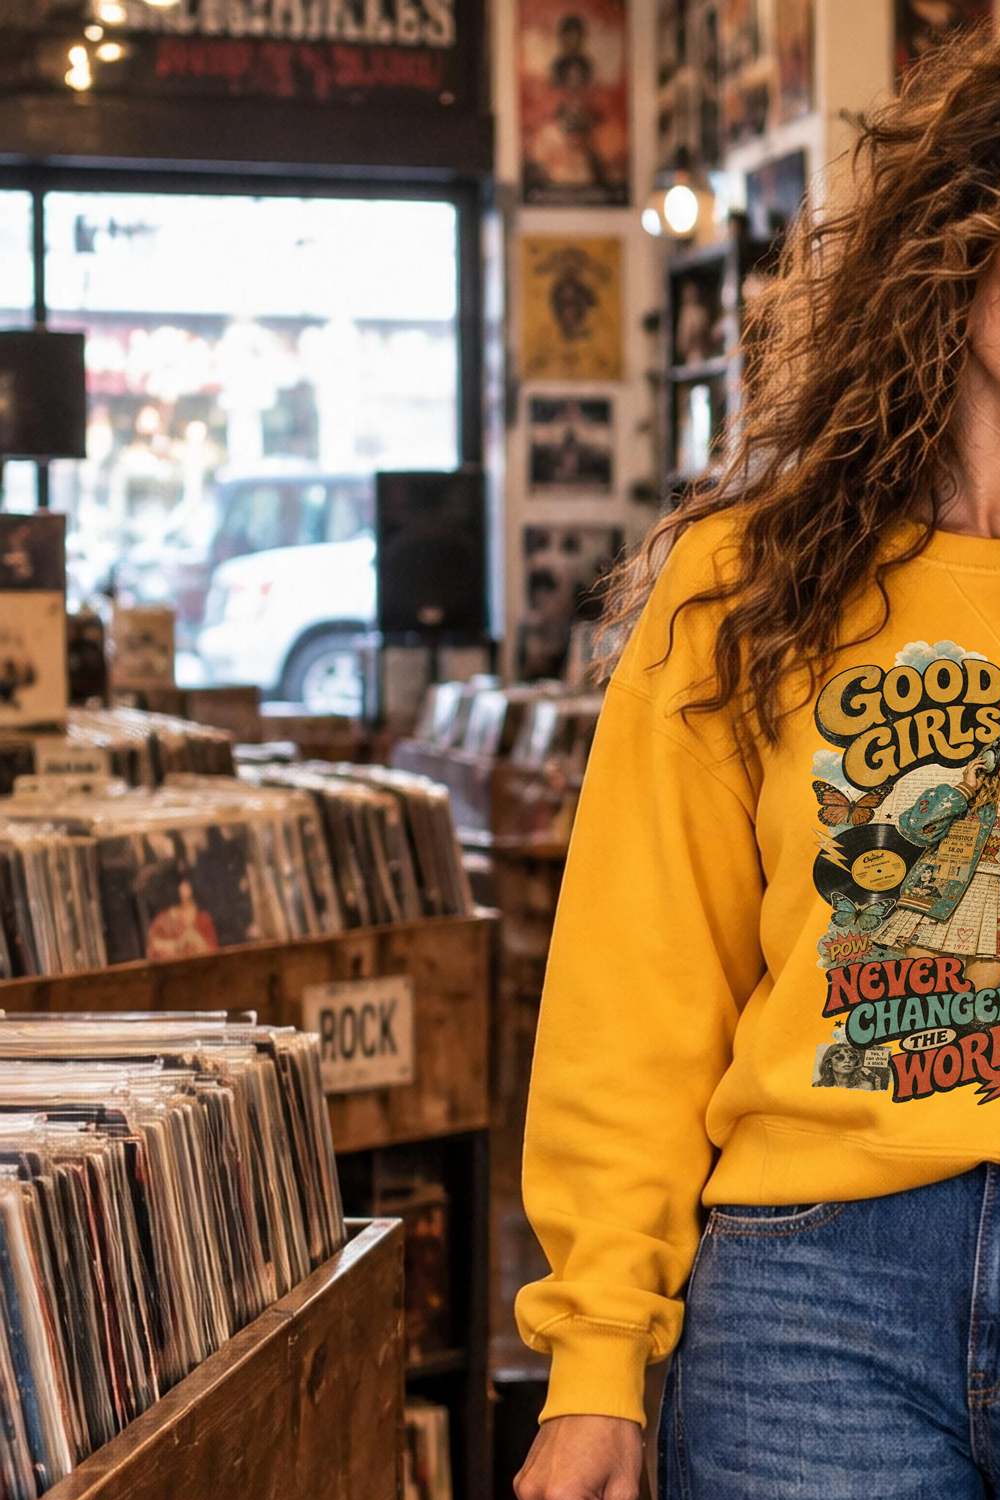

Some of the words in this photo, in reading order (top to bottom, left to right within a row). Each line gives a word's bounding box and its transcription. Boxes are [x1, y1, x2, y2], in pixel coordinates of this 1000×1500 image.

[825, 956, 972, 1012] NEVER
[318, 997, 399, 1063] ROCK
[908, 1029, 949, 1049] THE
